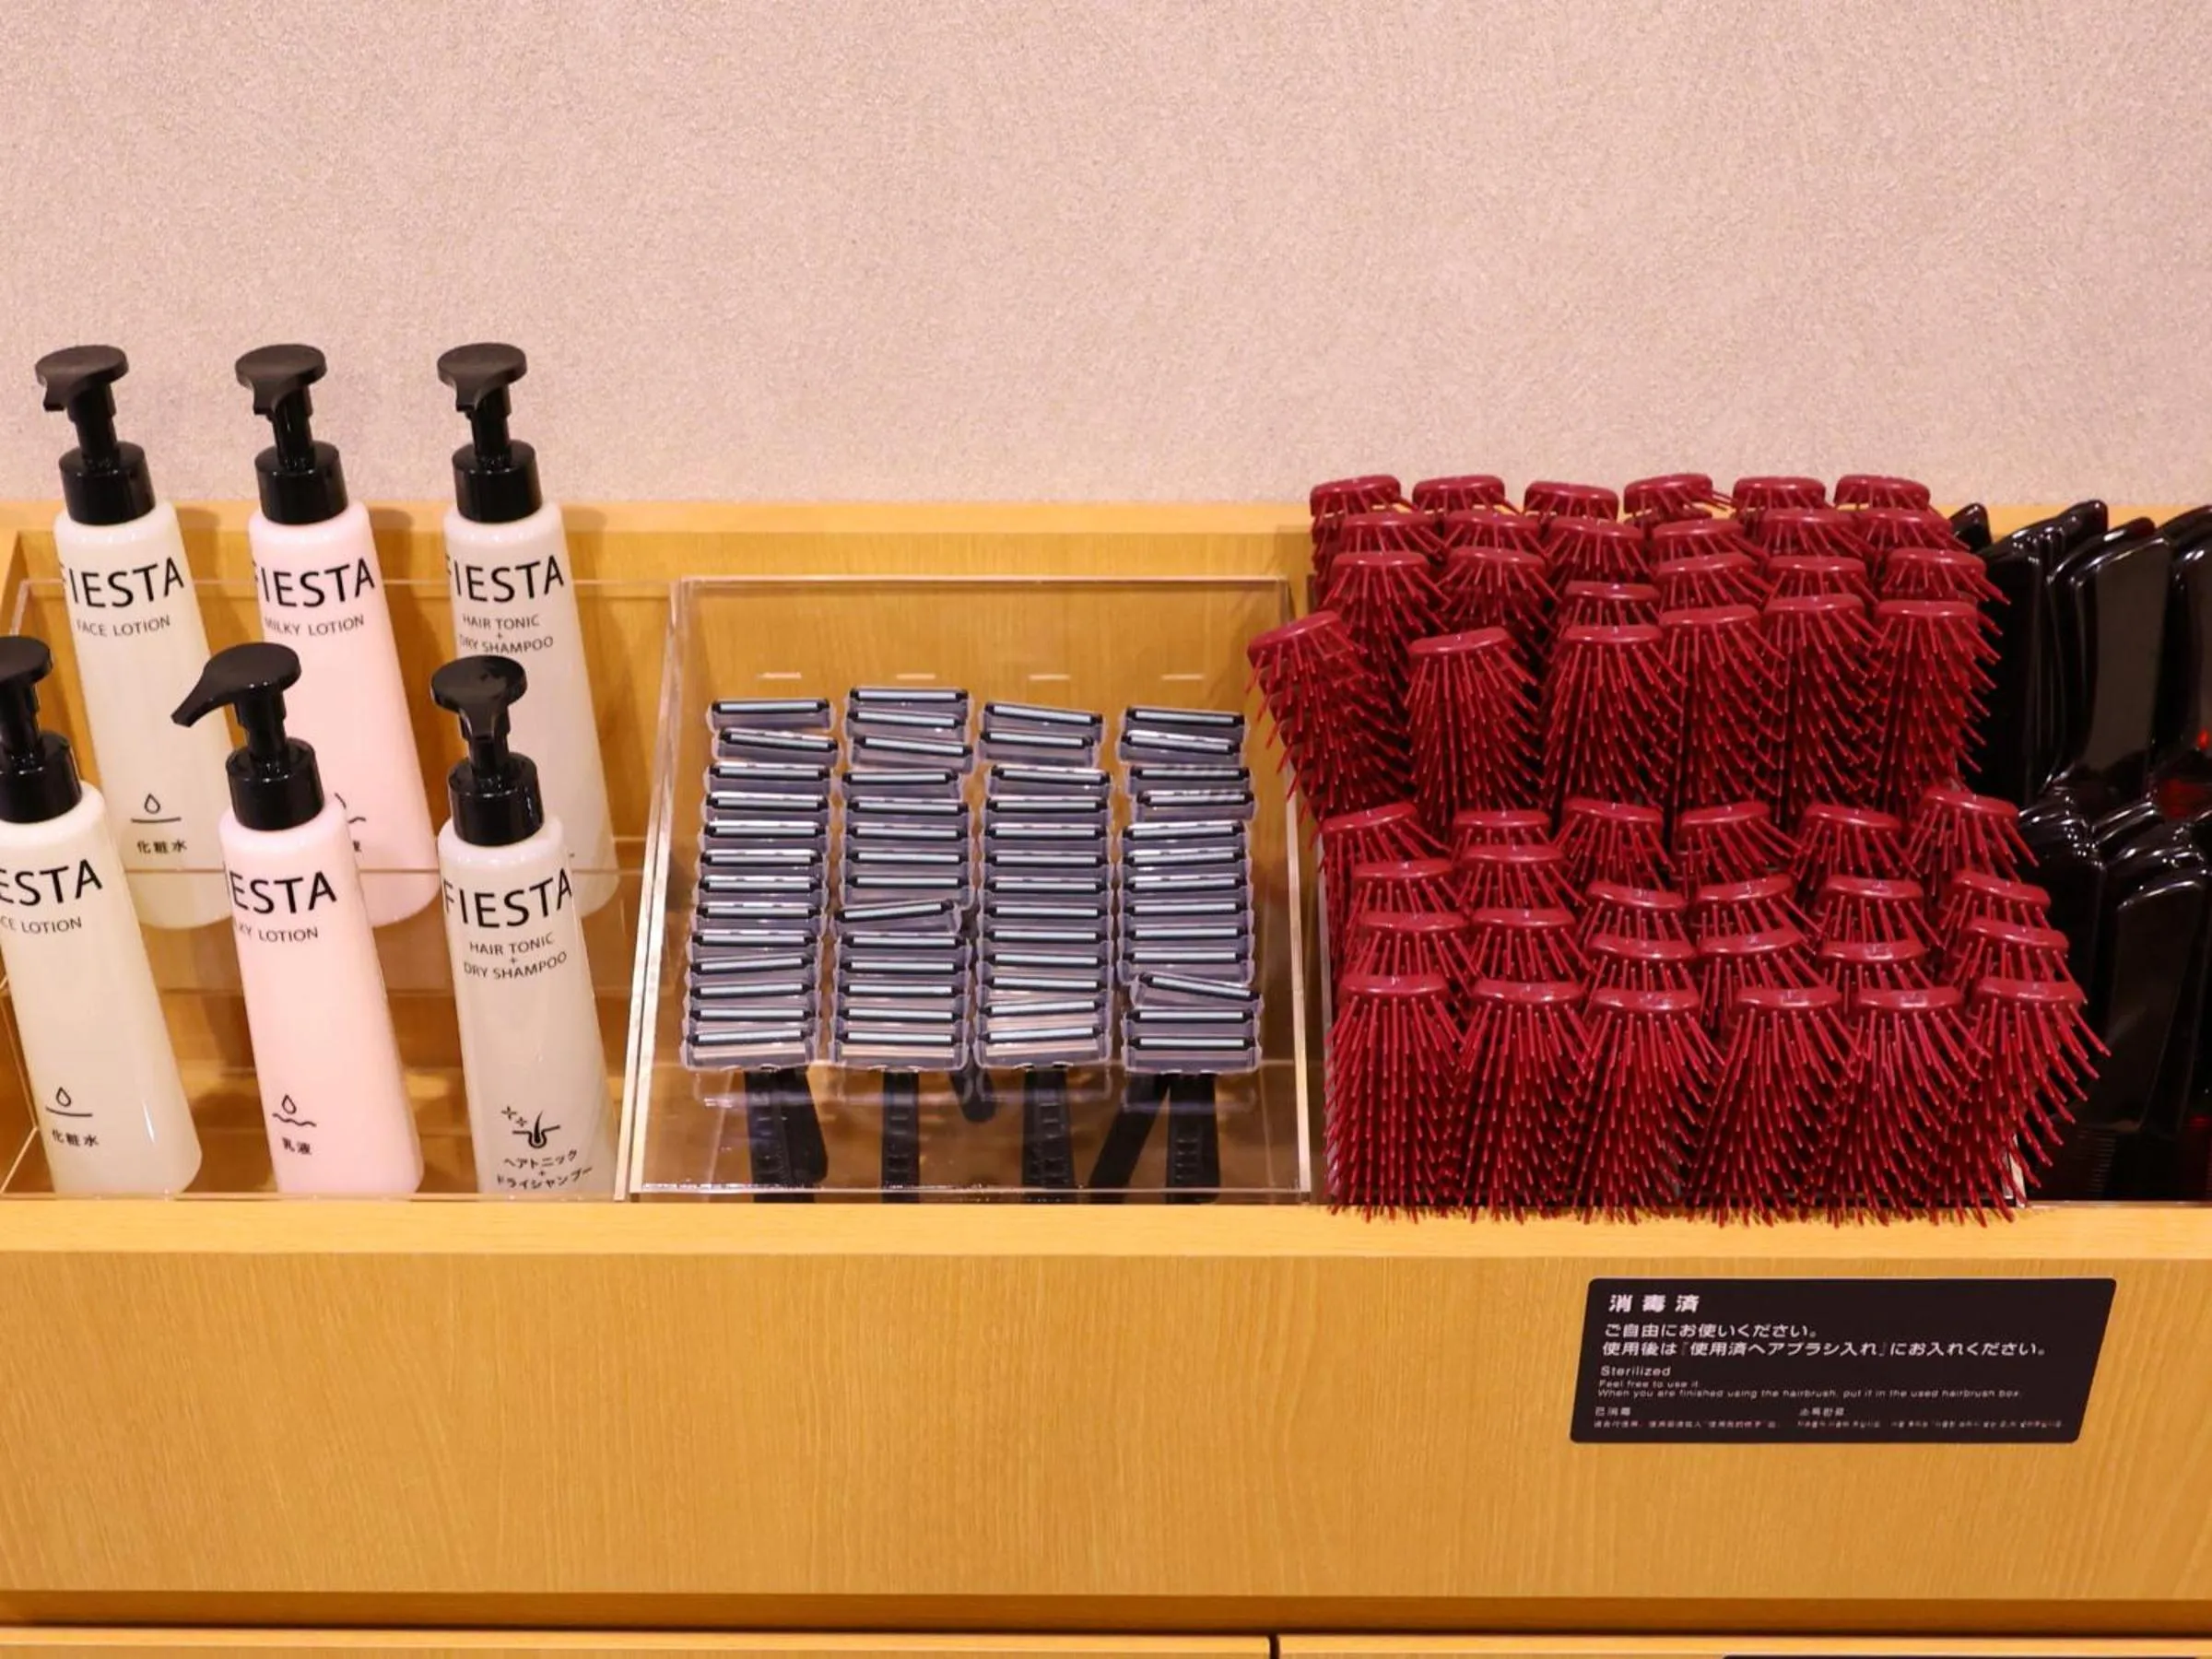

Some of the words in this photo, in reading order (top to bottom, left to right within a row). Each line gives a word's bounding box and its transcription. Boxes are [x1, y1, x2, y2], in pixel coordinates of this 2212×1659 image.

[59, 555, 184, 608] IESTA
[253, 557, 375, 608] IESTA
[445, 554, 564, 604] IESTA
[76, 617, 108, 637] FACE
[112, 613, 171, 637] LOTION
[308, 613, 364, 637] LOTION
[463, 613, 491, 630] HAIR
[495, 614, 540, 630] TONIC
[482, 636, 554, 653] SHAMPOO
[136, 839, 187, 854] 化粧水
[0, 858, 103, 907] ESTA
[229, 870, 337, 915] ESTA
[443, 867, 572, 929] FIESTA
[0, 914, 17, 931] CE
[21, 916, 82, 935] LOTION
[258, 926, 319, 943] LOTION
[469, 941, 503, 956] HAIR
[509, 931, 556, 955] TONIC
[464, 961, 488, 978] DRY
[493, 950, 568, 981] SHAMPOO
[52, 1128, 100, 1147] 化粧水
[282, 1137, 313, 1156] 乳液
[503, 1148, 578, 1170] ヘアトニック
[1605, 1323, 1817, 1338] ご自由にお使いください。
[1600, 1365, 1672, 1377] Sterilized
[1597, 1389, 1630, 1397] When
[1633, 1391, 1654, 1399] you
[1679, 1389, 1723, 1397] finished
[1727, 1390, 1758, 1399] using
[1761, 1389, 1780, 1397] the
[1842, 1390, 1862, 1399] put
[1889, 1389, 1907, 1397] the
[1911, 1389, 1939, 1397] used
[1599, 1380, 1623, 1388] Feel
[1627, 1380, 1650, 1388] free
[1653, 1380, 1664, 1388] to
